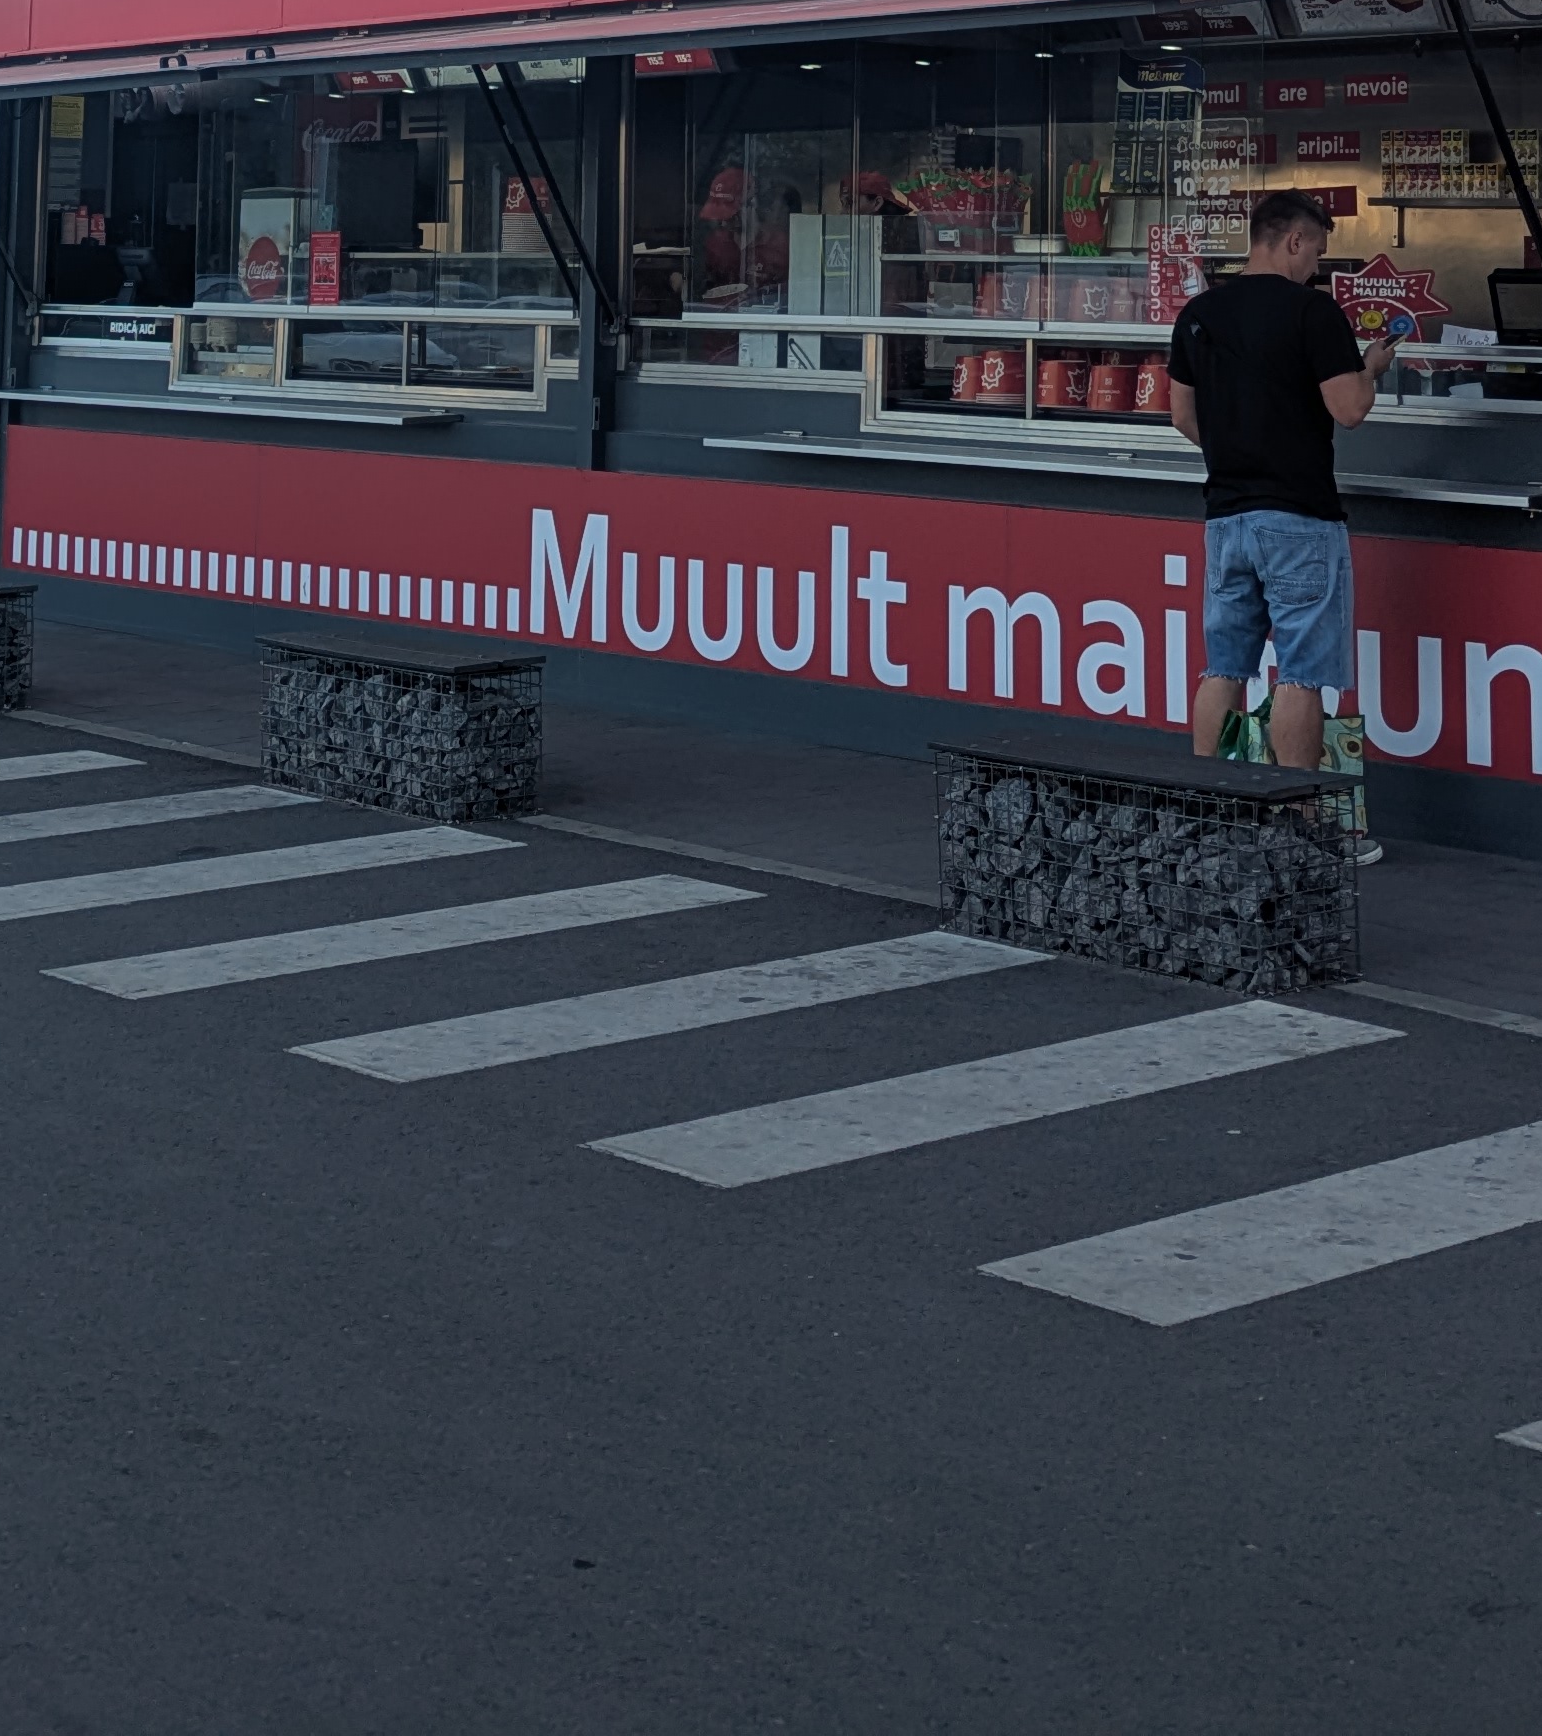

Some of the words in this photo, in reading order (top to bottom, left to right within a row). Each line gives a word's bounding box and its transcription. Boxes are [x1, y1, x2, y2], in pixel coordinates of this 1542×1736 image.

[1279, 87, 1308, 102] are
[1346, 76, 1408, 98] nevoie
[1188, 138, 1237, 151] CUCURIGO
[1237, 138, 1258, 157] de
[1173, 157, 1241, 172] PROGRAM
[1150, 225, 1161, 322] CUCURIGO
[1353, 277, 1408, 288] MUUULT
[1352, 287, 1376, 297] MAI
[1379, 287, 1406, 298] BUN
[138, 323, 156, 335] AICI
[529, 507, 909, 688] Muuult
[948, 554, 1189, 726] mai
